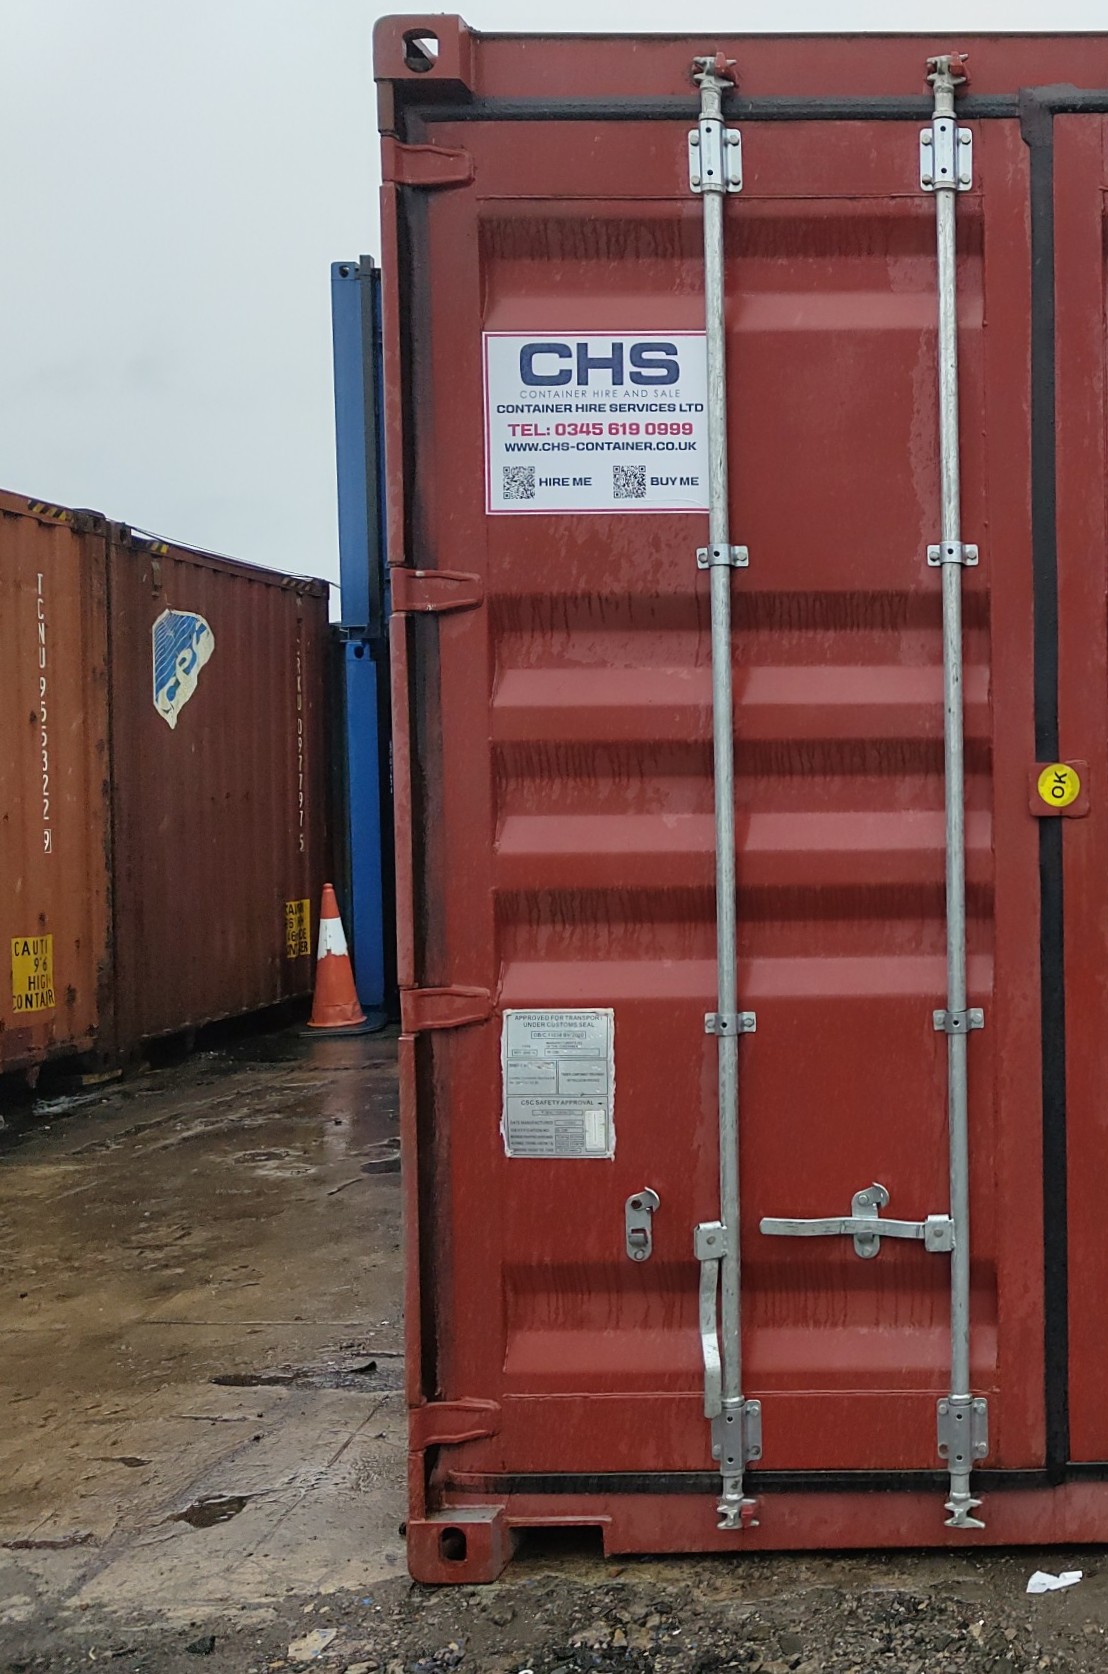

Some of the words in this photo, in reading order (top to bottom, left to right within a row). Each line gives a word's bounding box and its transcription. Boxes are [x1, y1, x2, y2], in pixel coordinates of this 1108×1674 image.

[519, 342, 680, 386] CHS
[520, 390, 587, 399] CONTAINER
[593, 389, 618, 398] HIRE
[624, 389, 649, 398] AND
[654, 389, 681, 398] SALE
[496, 404, 573, 413] CONTAINER
[575, 404, 606, 413] HIRE
[609, 403, 677, 412] SERVICES
[679, 403, 704, 412] LTD
[507, 423, 550, 437] TEL:
[554, 422, 604, 436] 0345
[608, 422, 640, 436] 619
[644, 422, 693, 435] 0999
[504, 441, 697, 452] WWW.CHS-CONTAINER.CO.UK
[538, 477, 570, 487] HIRE
[573, 477, 592, 486] ME
[650, 477, 678, 486] BUY
[679, 477, 699, 486] ME
[37, 573, 46, 668] TCNU
[40, 677, 49, 820] 955322
[1051, 771, 1067, 799] OK
